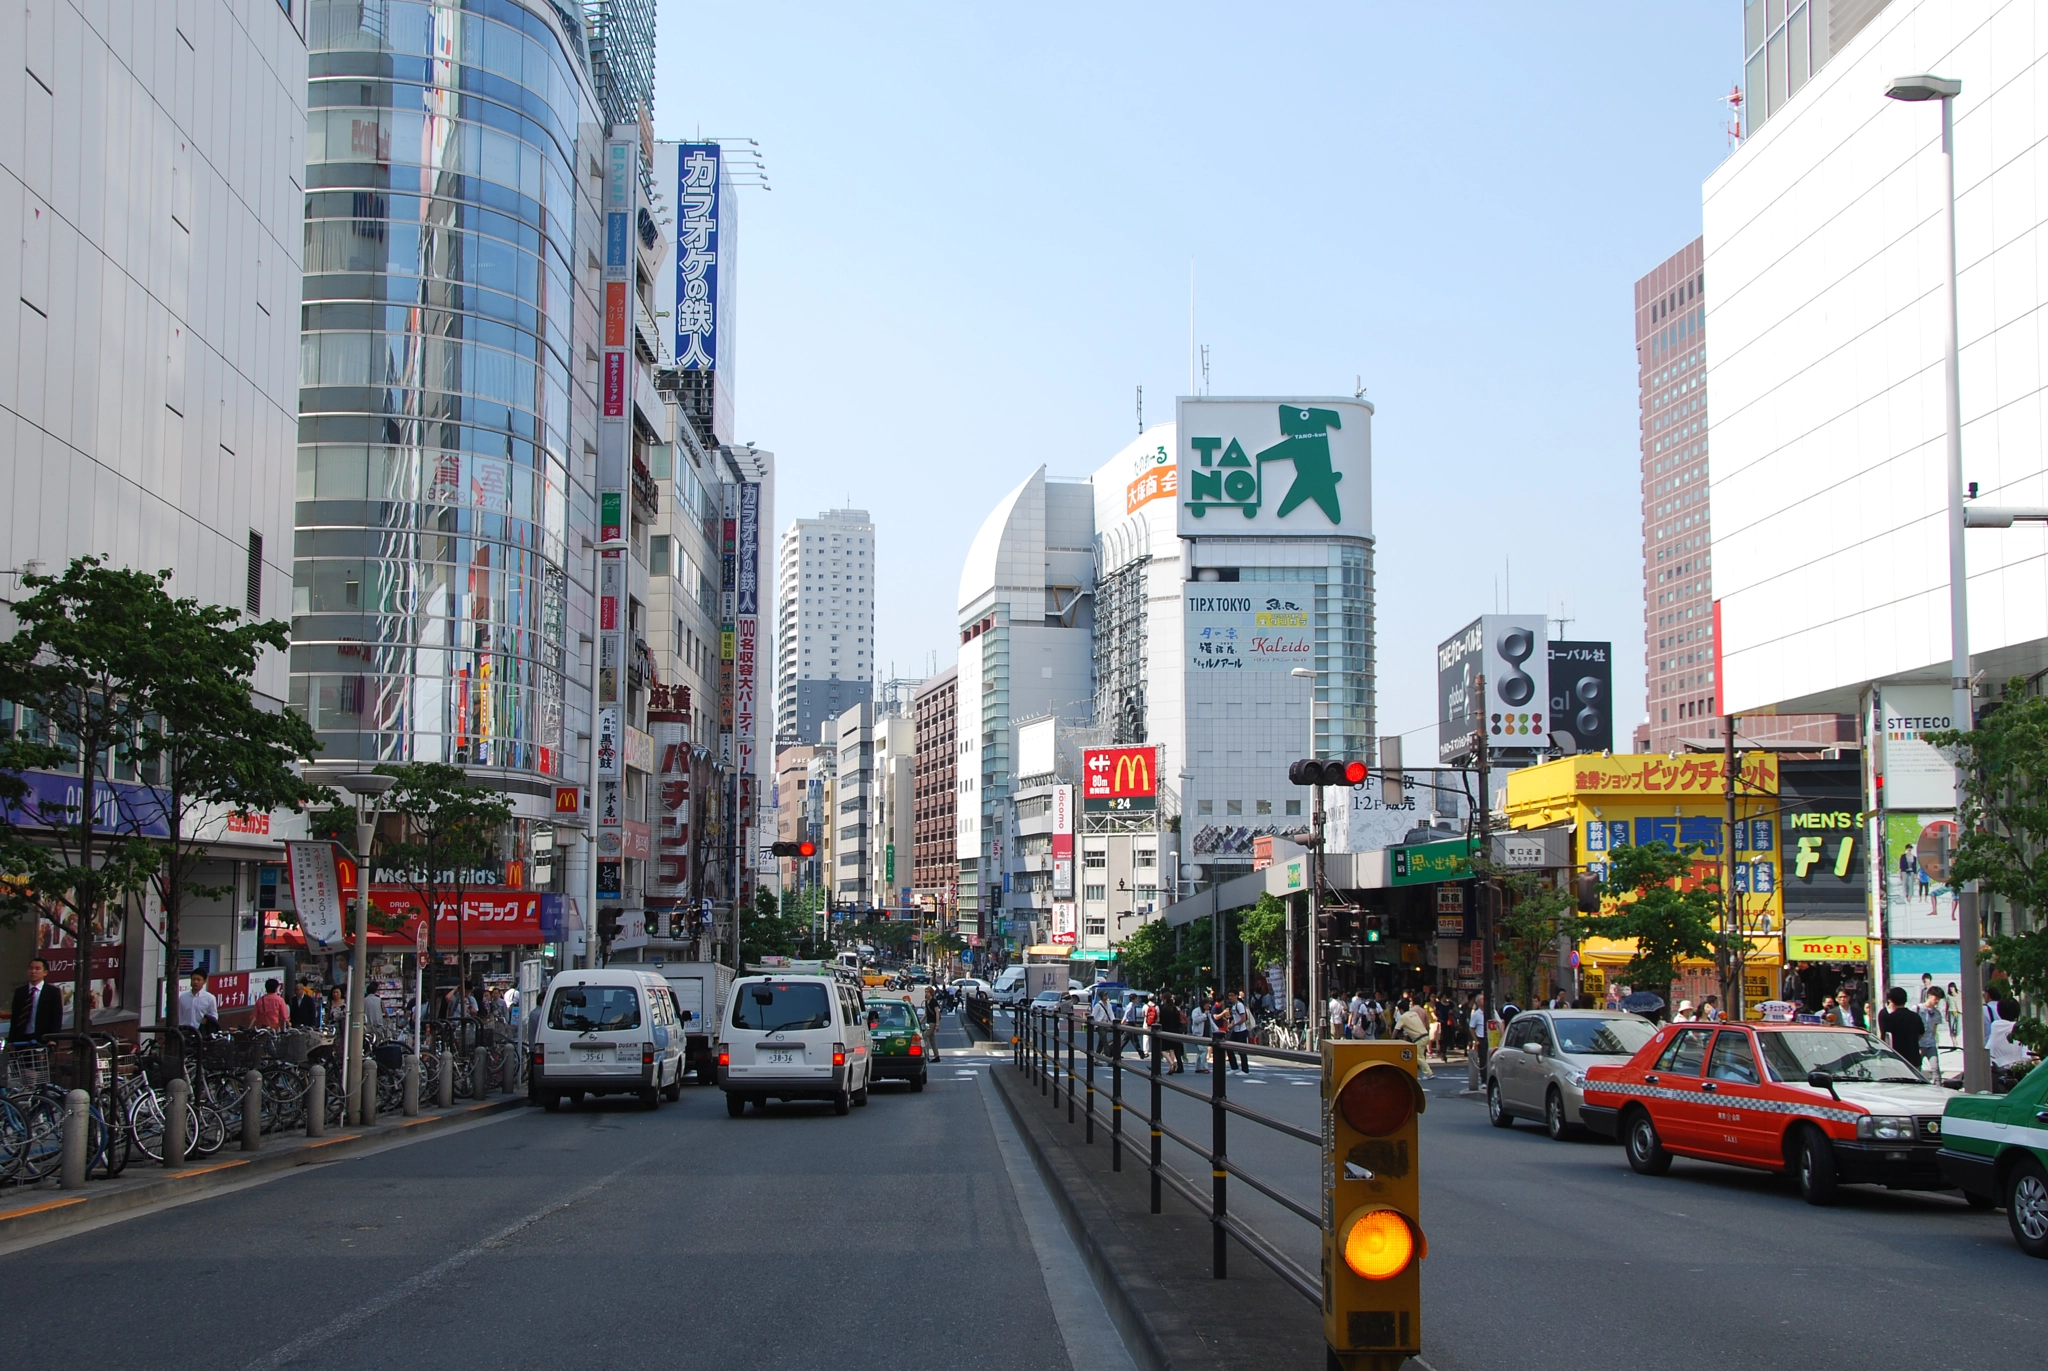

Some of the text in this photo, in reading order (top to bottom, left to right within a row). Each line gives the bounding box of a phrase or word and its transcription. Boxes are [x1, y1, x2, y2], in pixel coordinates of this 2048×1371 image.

[612, 162, 625, 203] アメミヤ
[677, 150, 717, 368] カラオケの鉄人
[616, 298, 624, 320] クロス
[607, 305, 616, 342] クリニック
[1294, 431, 1327, 440] TANO-kun
[739, 483, 758, 613] カラオケの鉄人
[1216, 597, 1251, 612] TOKYO
[1249, 636, 1310, 655] Kaleido
[648, 683, 691, 711] 麻雀
[1887, 716, 1951, 729] STETECO
[1092, 775, 1108, 787] 80m
[66, 785, 119, 828] ODKYU
[658, 741, 692, 885] パチンコ
[1117, 798, 1131, 809] 24
[1791, 811, 1852, 829] MEN'S
[1589, 821, 1604, 849] 新幹線
[1634, 815, 1724, 856] 販売
[1755, 820, 1770, 849] 株主券
[1756, 862, 1771, 892] 食事券
[1803, 941, 1862, 955] men's
[1723, 1134, 1738, 1144] TAXI
